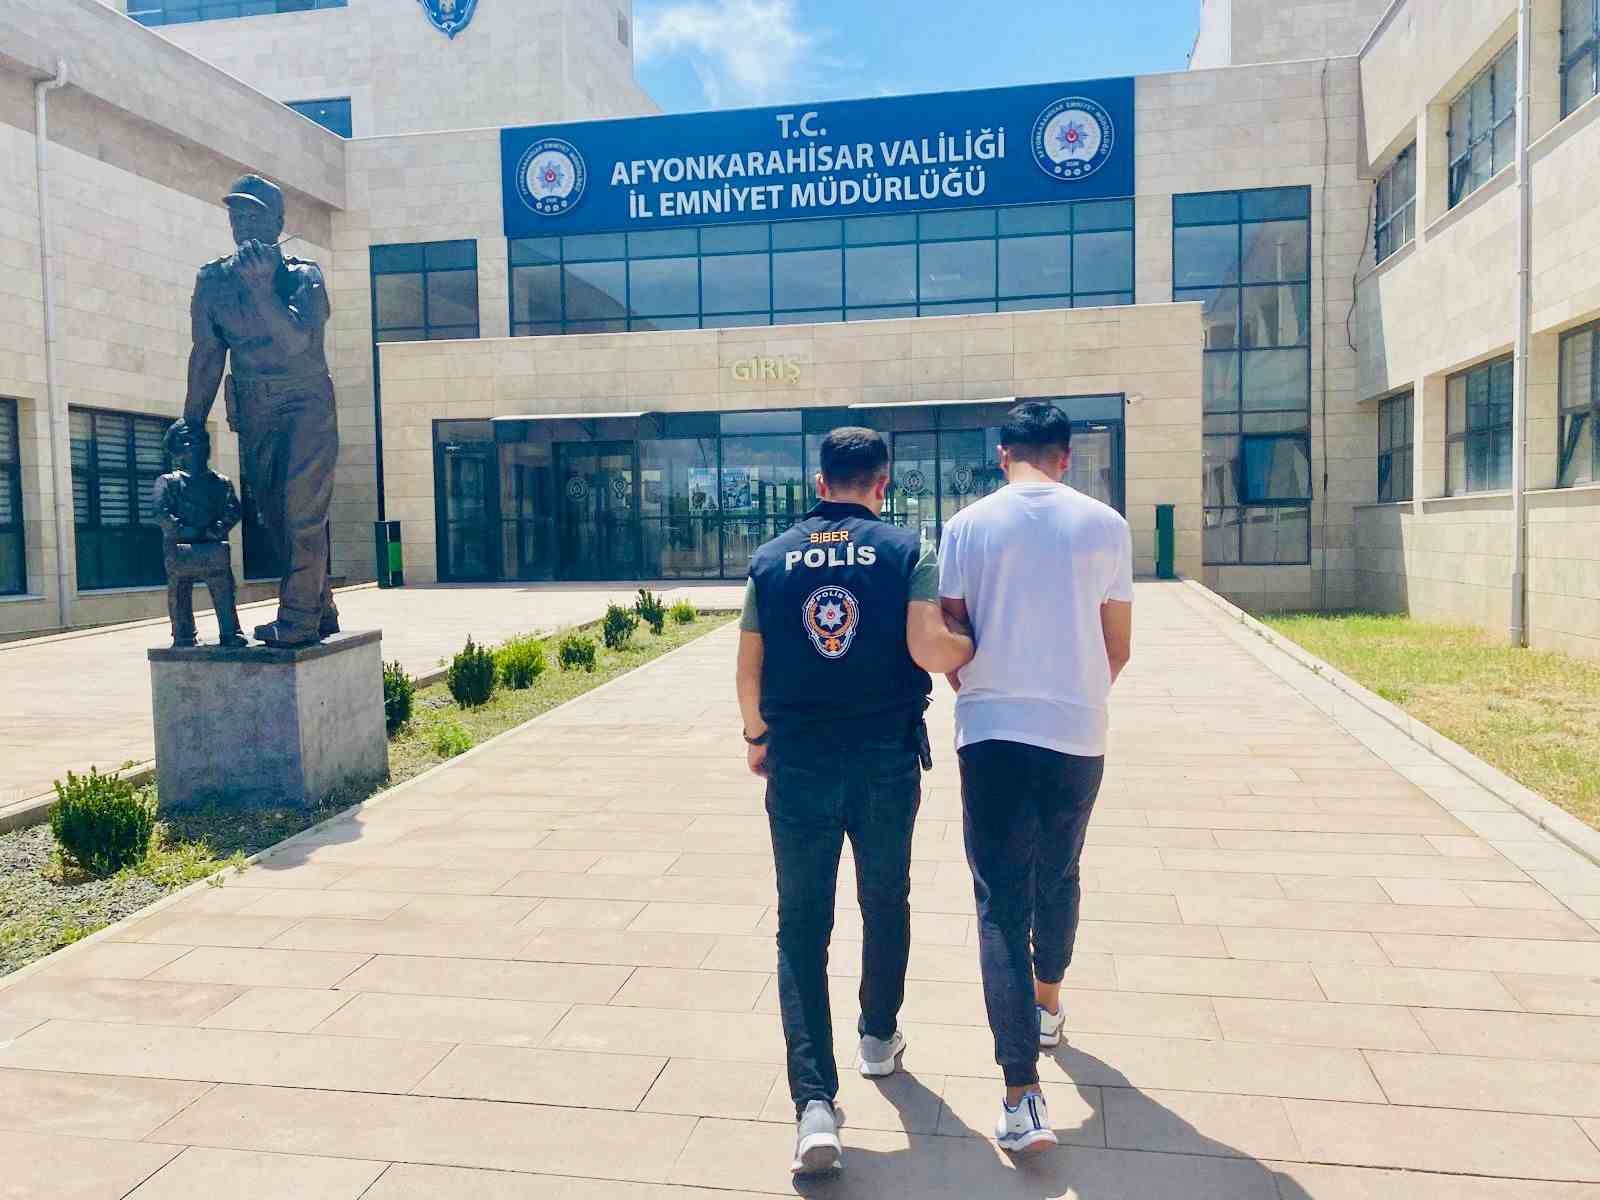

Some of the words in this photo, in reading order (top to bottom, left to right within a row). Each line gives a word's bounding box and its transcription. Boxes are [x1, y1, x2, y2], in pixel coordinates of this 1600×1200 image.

[776, 112, 827, 138] T.C.
[611, 142, 875, 186] AFYONKARAHİSAR
[880, 127, 1005, 166] VALİLİĞİ
[629, 189, 653, 219] İL
[659, 183, 784, 217] EMNİYET
[790, 165, 987, 208] MÜDÜRLÜĞÜ
[732, 353, 801, 384] GİRİŞ
[785, 542, 877, 571] POLİS
